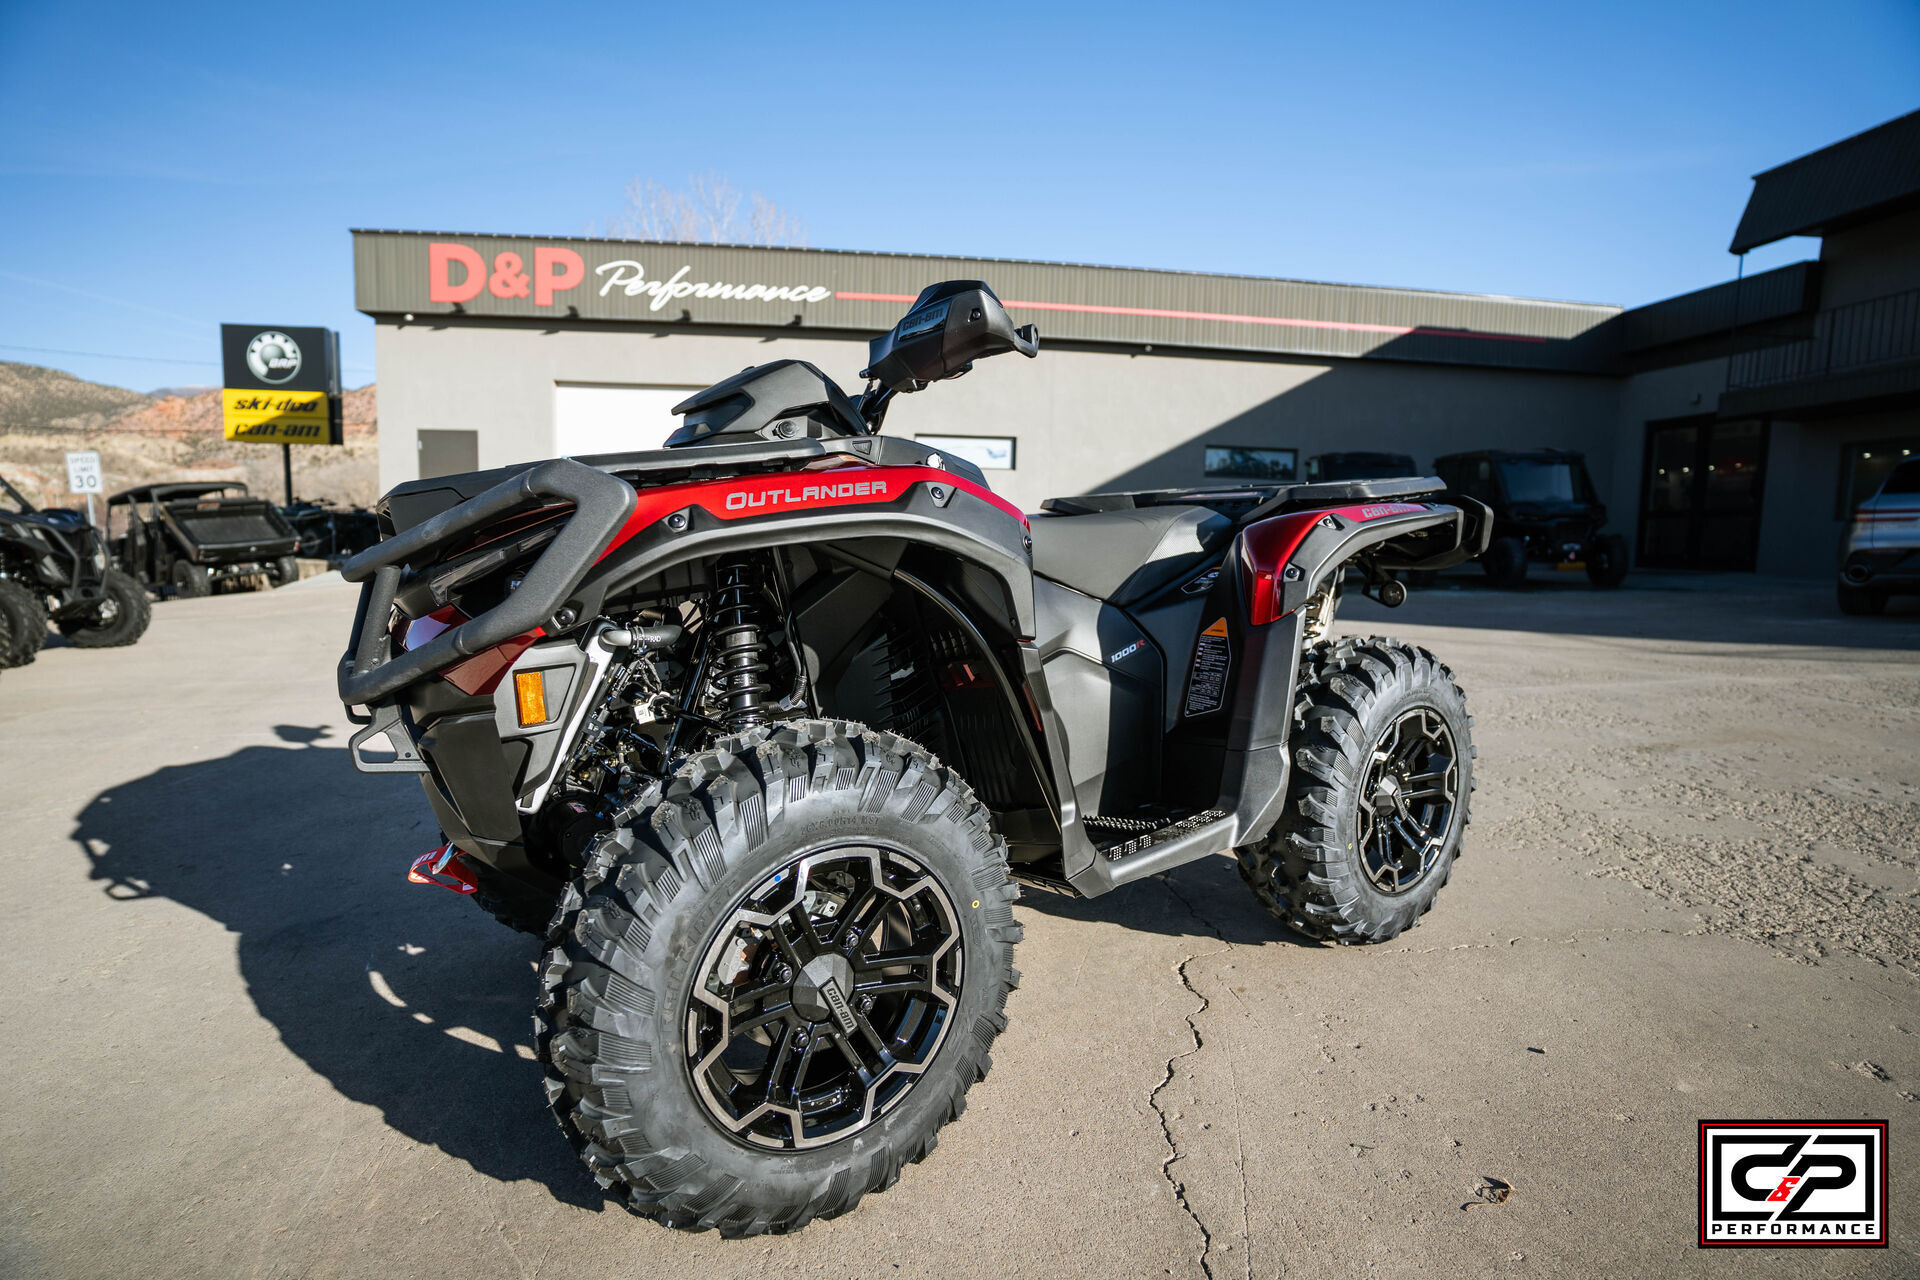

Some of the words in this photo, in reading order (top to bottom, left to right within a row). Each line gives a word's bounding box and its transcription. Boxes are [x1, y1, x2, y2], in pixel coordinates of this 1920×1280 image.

[428, 242, 585, 307] D&P
[595, 259, 831, 312] Performance
[234, 398, 319, 412] ski-doo
[235, 424, 321, 437] can-am
[75, 475, 97, 488] 30
[725, 481, 887, 510] OUTLANDER
[1111, 639, 1145, 663] 1000R
[827, 987, 855, 1029] can-am
